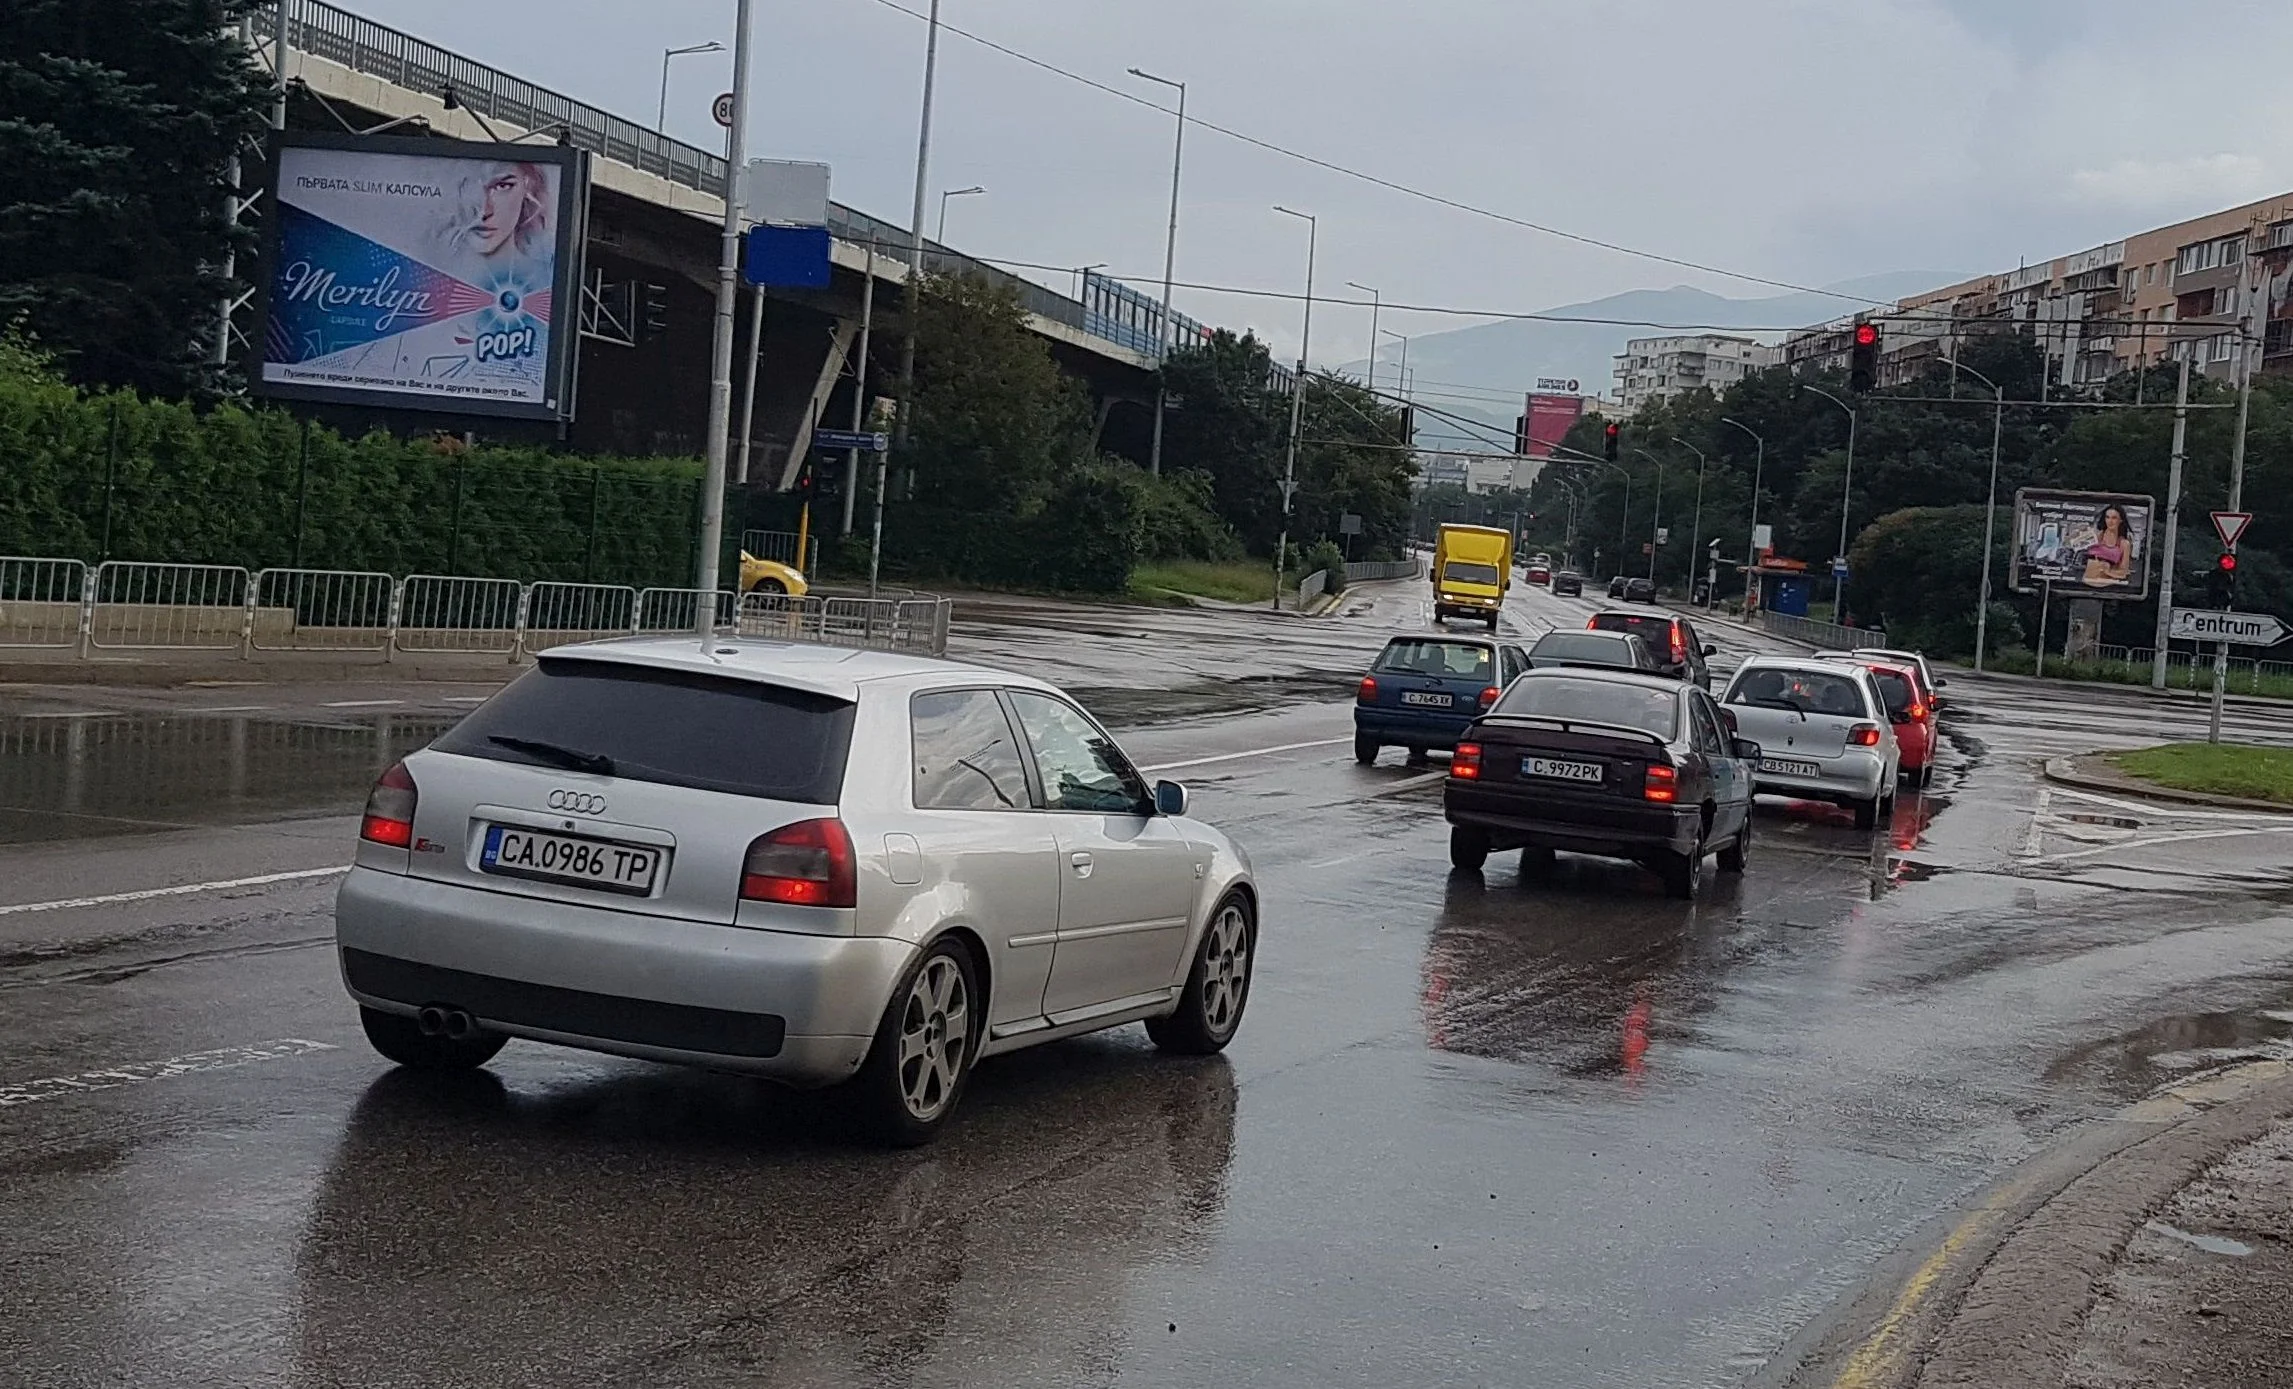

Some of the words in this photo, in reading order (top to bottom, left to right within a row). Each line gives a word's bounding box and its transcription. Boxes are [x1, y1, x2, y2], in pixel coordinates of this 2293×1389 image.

[297, 176, 349, 191] ПЪРВАТА
[353, 181, 382, 195] SLIM
[386, 183, 442, 197] КАПСУЛА
[285, 261, 439, 331] Merilyn
[478, 326, 534, 360] POP!
